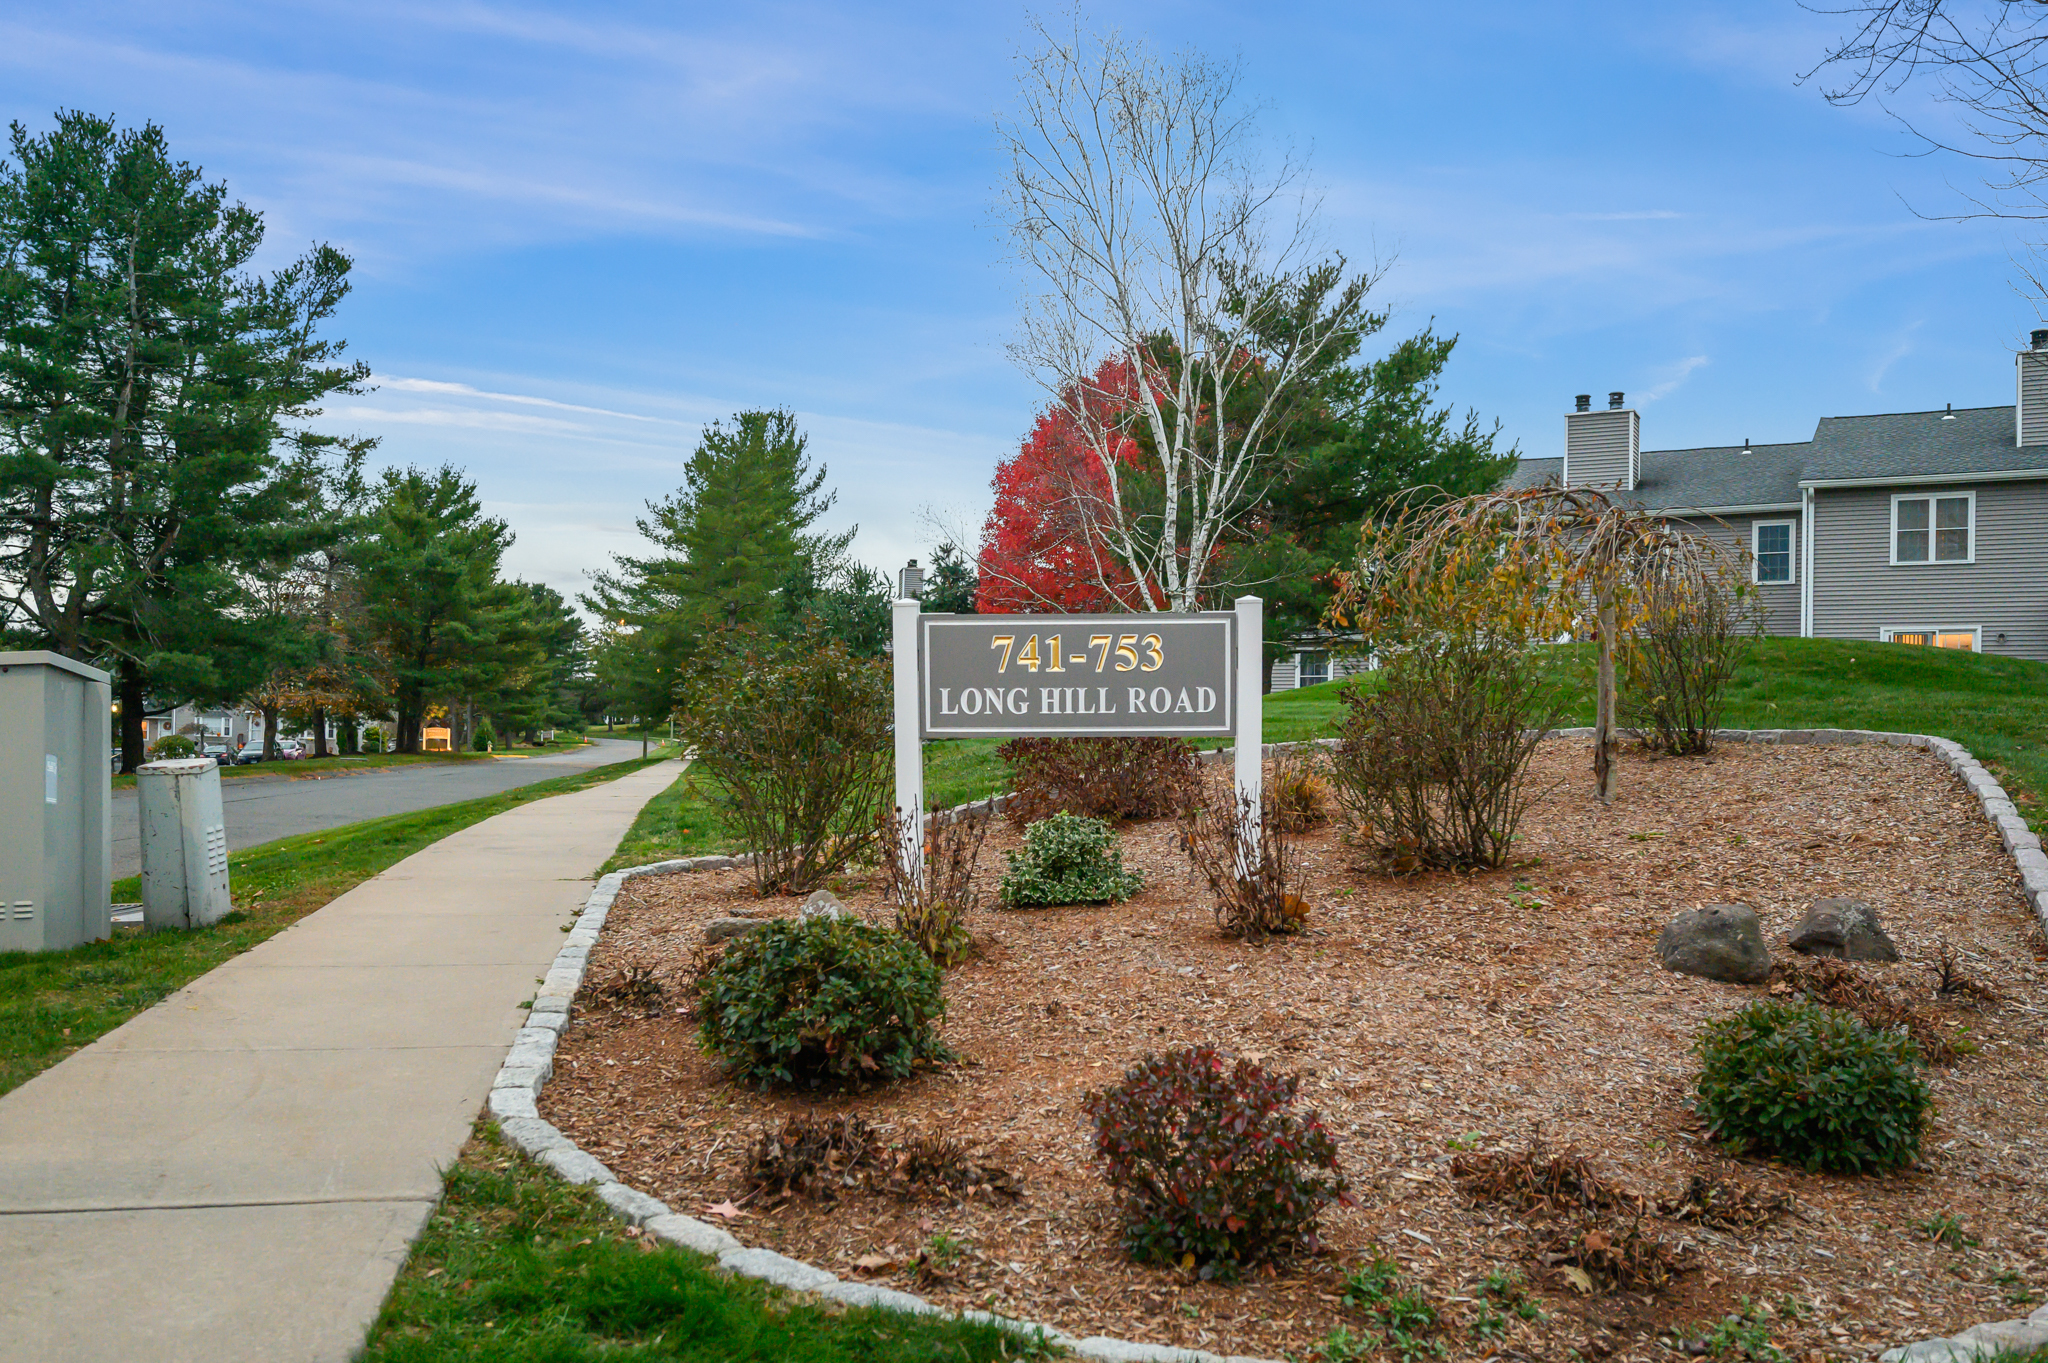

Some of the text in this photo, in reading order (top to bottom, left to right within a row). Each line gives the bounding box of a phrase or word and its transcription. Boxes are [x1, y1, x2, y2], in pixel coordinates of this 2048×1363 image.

[990, 634, 1165, 673] 741-753
[939, 686, 1218, 715] LONG HILL ROAD
